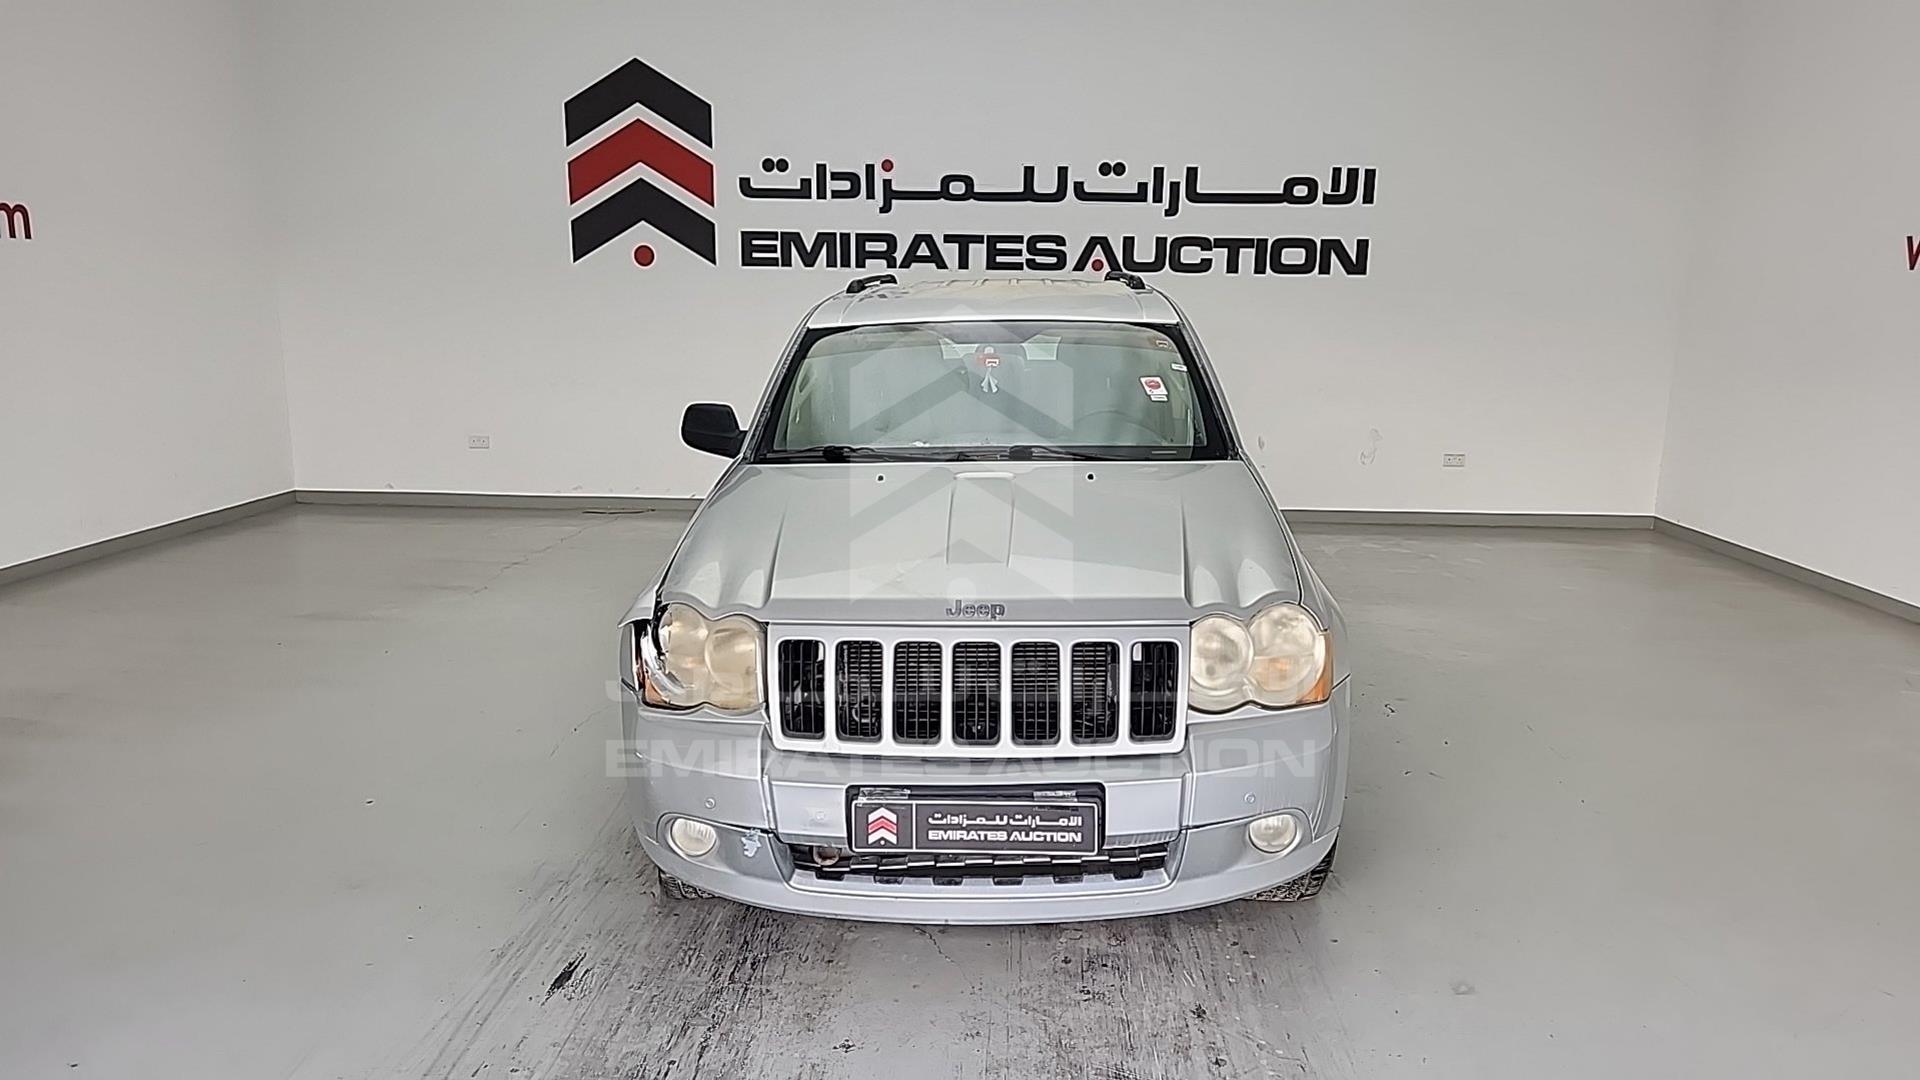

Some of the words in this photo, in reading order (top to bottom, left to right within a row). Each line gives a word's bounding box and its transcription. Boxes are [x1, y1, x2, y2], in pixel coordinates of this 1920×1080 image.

[741, 230, 1067, 271] EMIRATES
[1072, 236, 1369, 275] AUCTION
[945, 599, 1005, 620] Jeep
[928, 830, 1008, 841] EMIRATES
[1009, 831, 1082, 842] AUCTION
